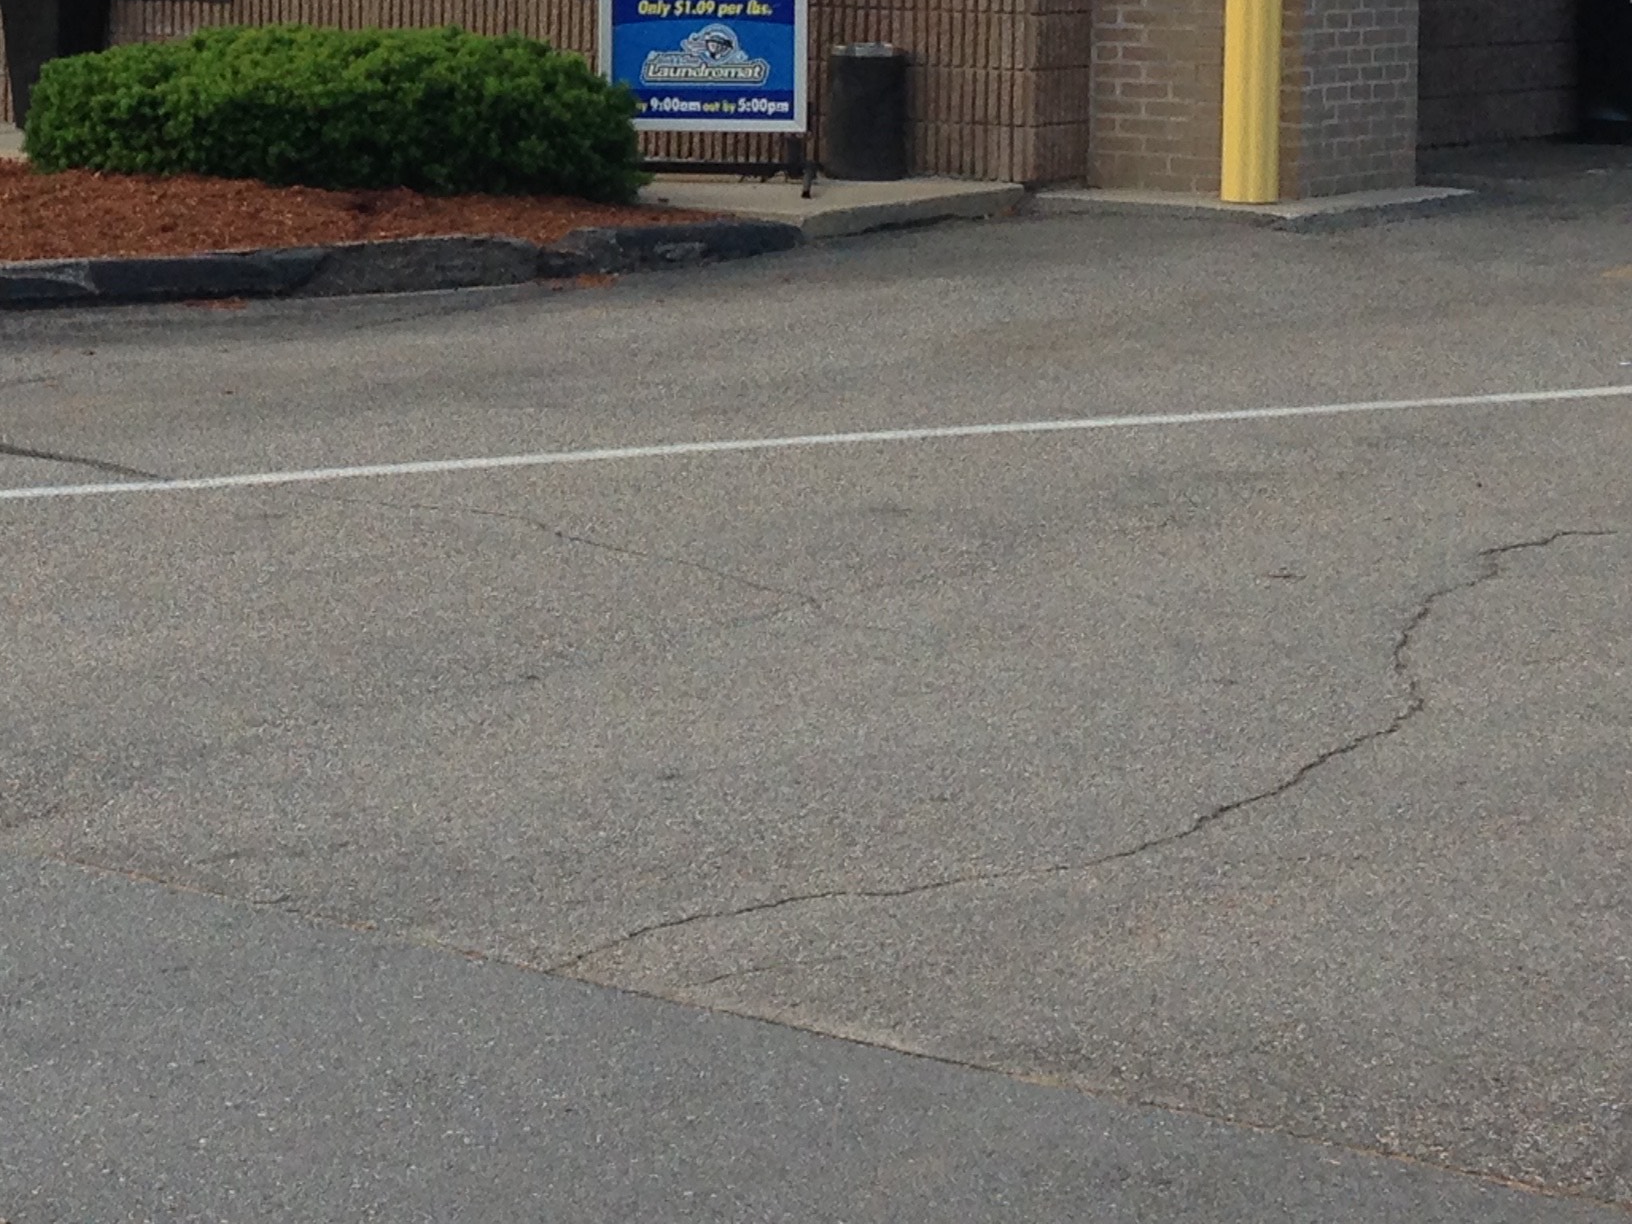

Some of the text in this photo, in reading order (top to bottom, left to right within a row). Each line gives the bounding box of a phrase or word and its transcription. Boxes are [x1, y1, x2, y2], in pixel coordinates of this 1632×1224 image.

[638, 0, 671, 18] Only
[718, 3, 742, 18] per
[647, 62, 763, 80] Laundromat
[650, 97, 701, 113] 9:00am
[737, 97, 790, 115] 5:00pm
